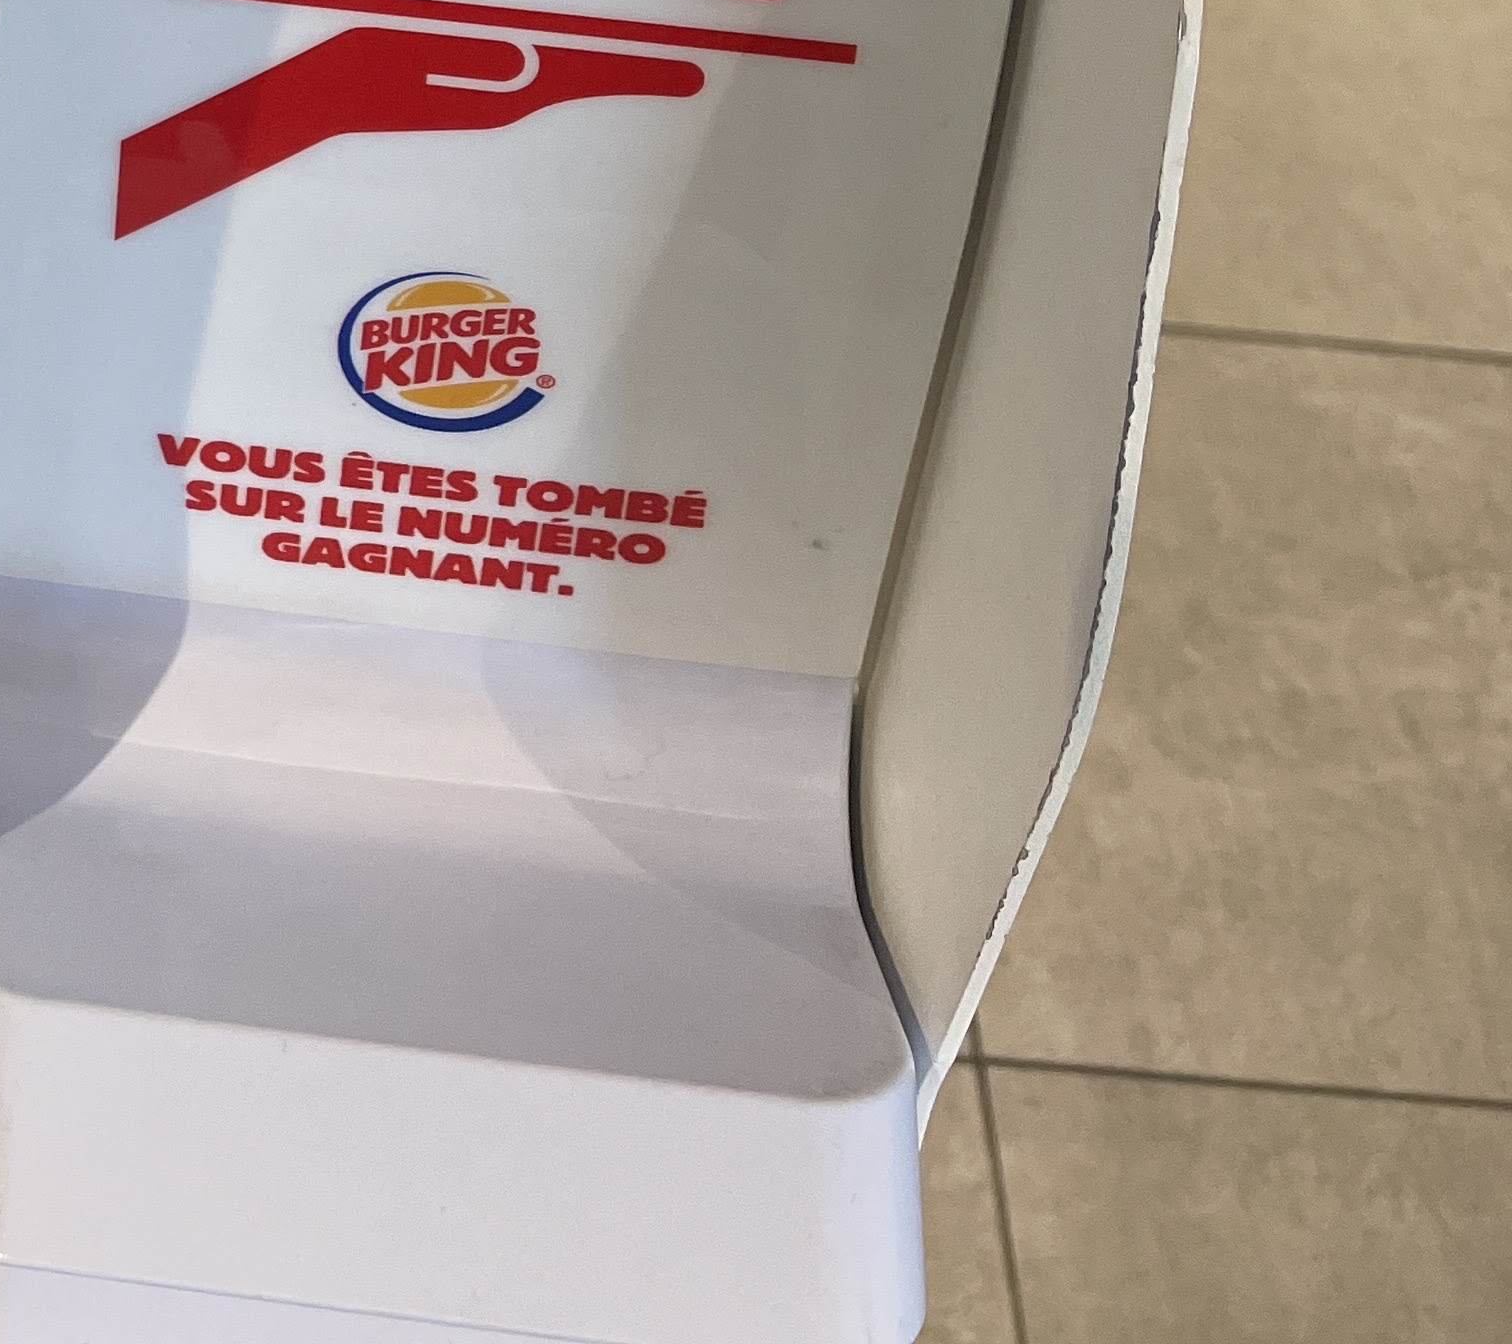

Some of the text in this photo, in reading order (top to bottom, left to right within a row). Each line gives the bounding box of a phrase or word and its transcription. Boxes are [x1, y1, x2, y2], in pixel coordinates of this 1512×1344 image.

[359, 308, 537, 351] BURGER
[364, 336, 541, 391] KING
[157, 433, 707, 528] VOUS ÊTES TOMBÉ
[185, 480, 666, 564] SUR LE NUMÉRO
[261, 532, 574, 596] GAGNANT.
